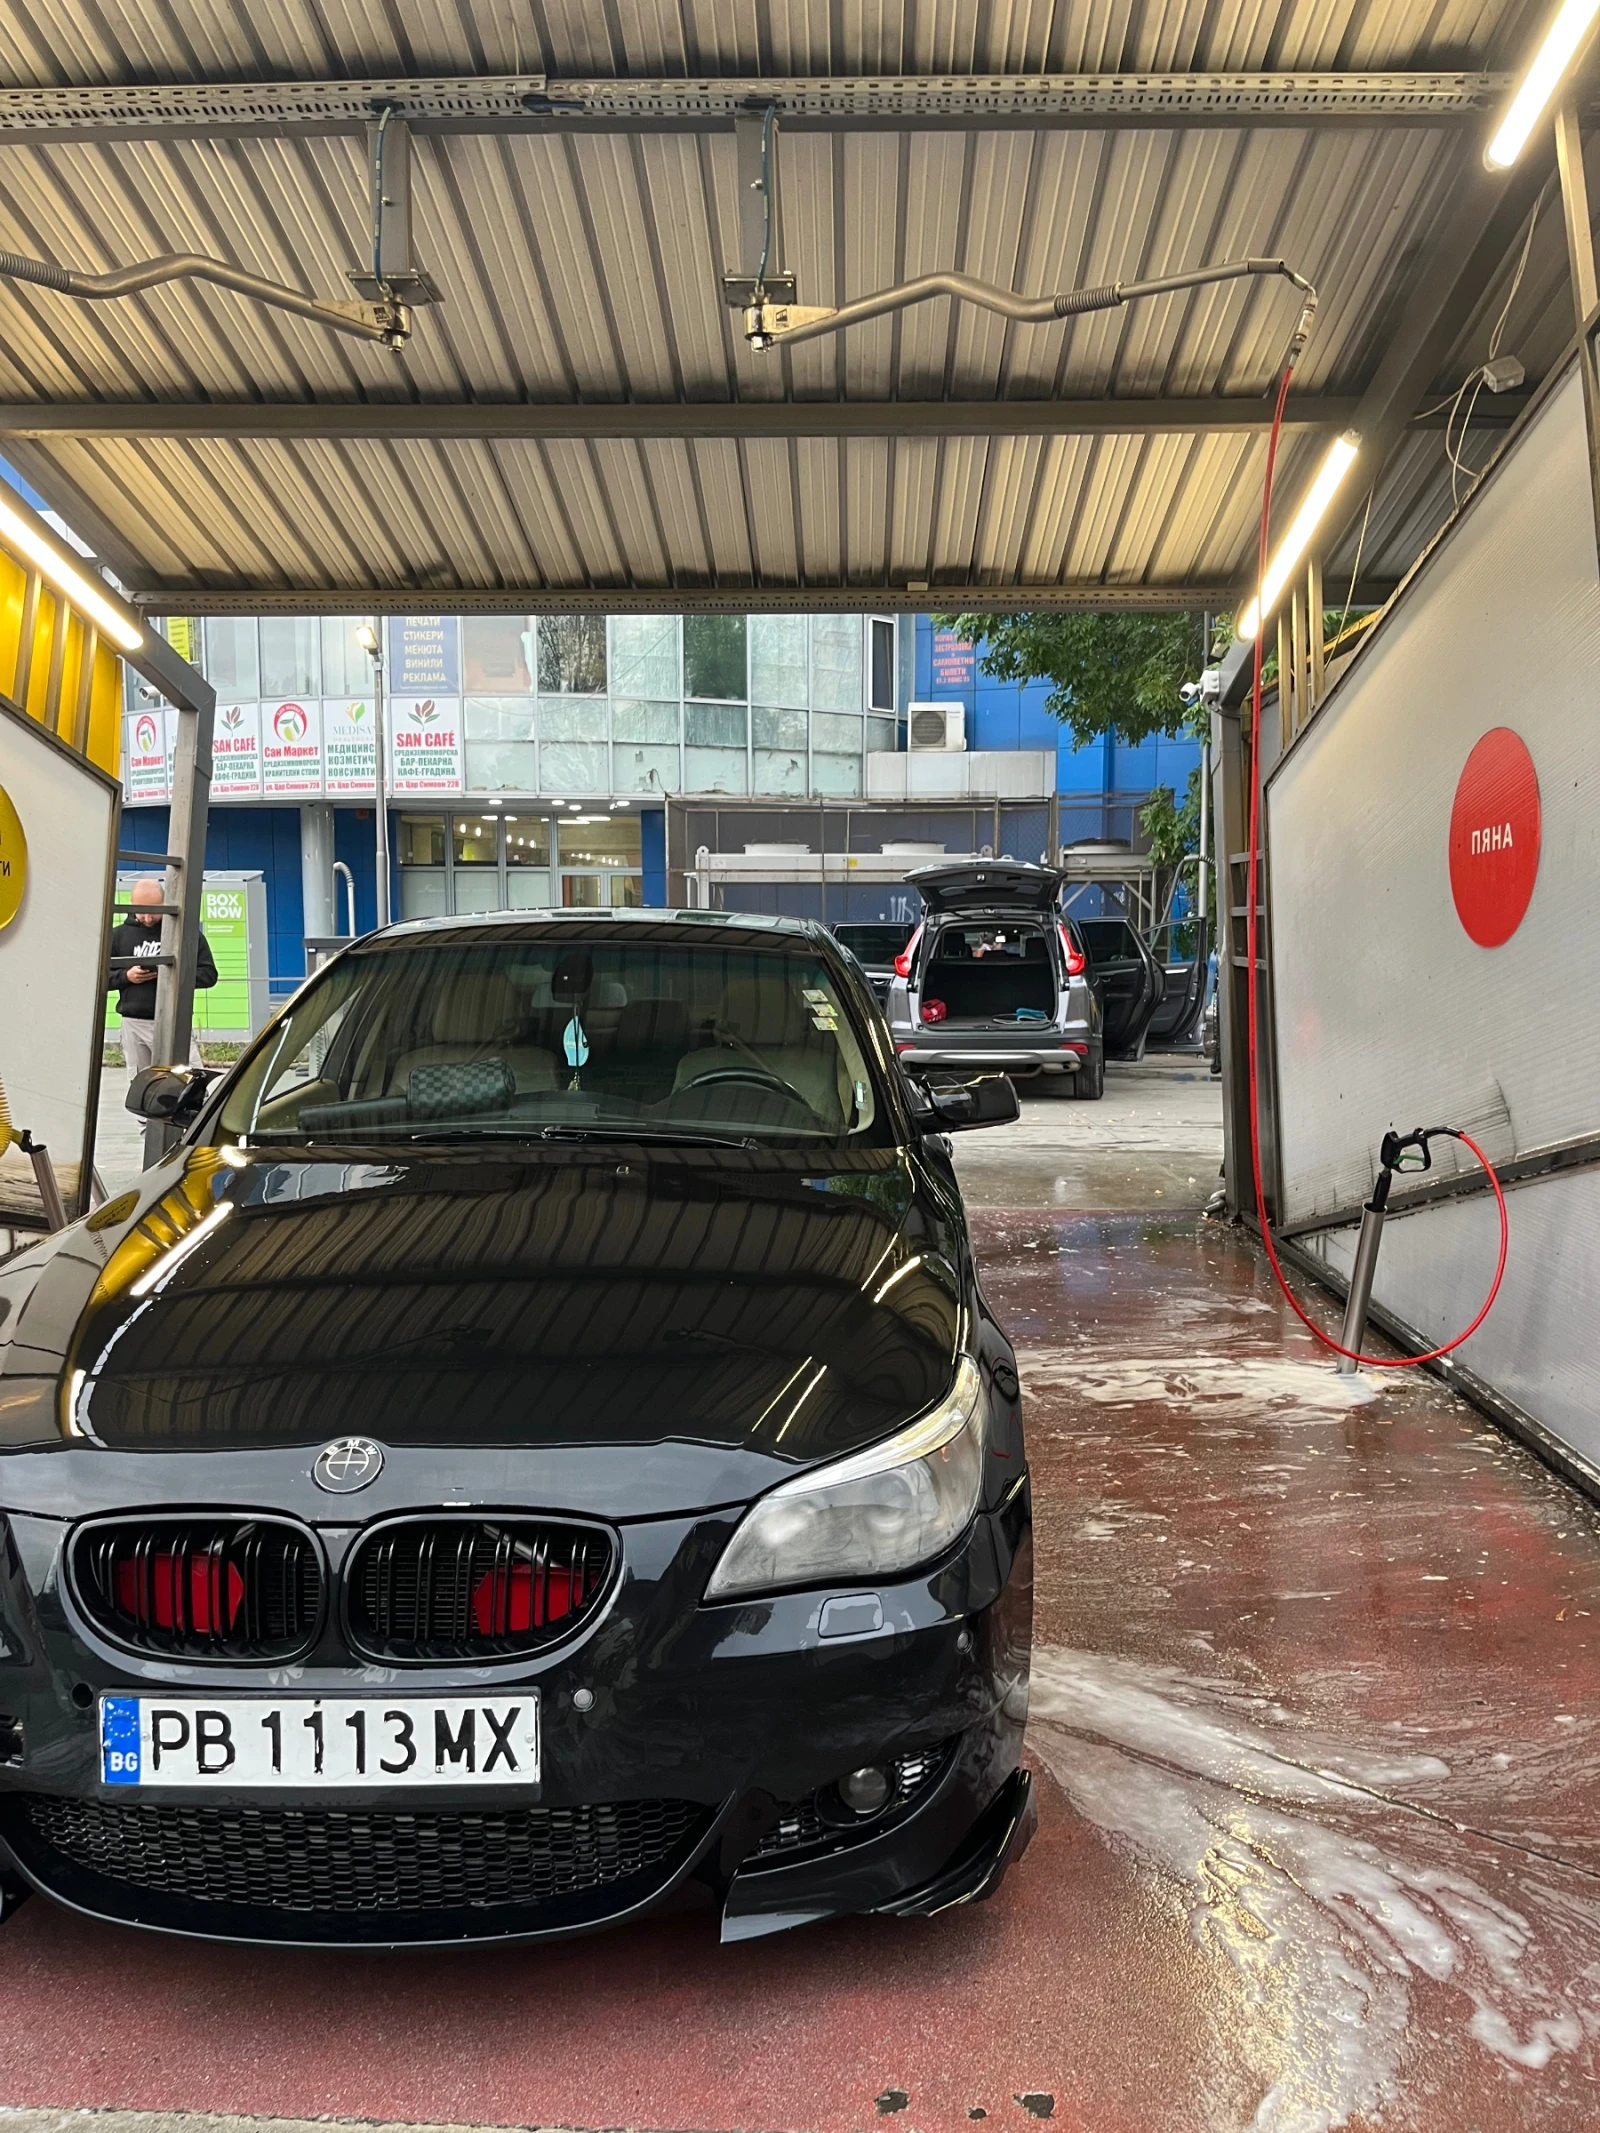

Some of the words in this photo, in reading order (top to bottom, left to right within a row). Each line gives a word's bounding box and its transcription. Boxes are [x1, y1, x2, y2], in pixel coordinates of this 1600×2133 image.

[406, 616, 441, 627] ПЕЧАТИ
[404, 631, 444, 641] СТИКЕРИ
[404, 645, 443, 655] МЕНЮТА
[405, 658, 443, 669] ВИНИЛИ
[403, 672, 447, 683] РЕКЛАМА
[213, 739, 231, 753] SAN
[233, 735, 256, 752] CAFÉ
[396, 733, 422, 747] SAN
[425, 730, 456, 747] CAFÉ
[263, 746, 282, 758] Сан
[284, 745, 319, 757] Маркет
[327, 743, 376, 755] МЕДИЦИНС
[328, 755, 376, 766] КОЗМЕТИЧ
[400, 757, 453, 766] БАР-ПЕКАРНА
[328, 767, 376, 777] КОНСУМАТИ
[398, 767, 456, 777] КАФЕ-ГРАДИНА
[405, 780, 418, 789] Цар
[419, 780, 446, 788] Симеон
[1472, 822, 1513, 856] ПЯНА
[206, 893, 239, 907] BOX
[207, 906, 242, 919] NOW
[325, 1439, 378, 1456] BMW
[151, 1709, 236, 1775] PB
[261, 1709, 417, 1775] 1113
[434, 1707, 521, 1773] MX
[110, 1751, 138, 1773] BG
